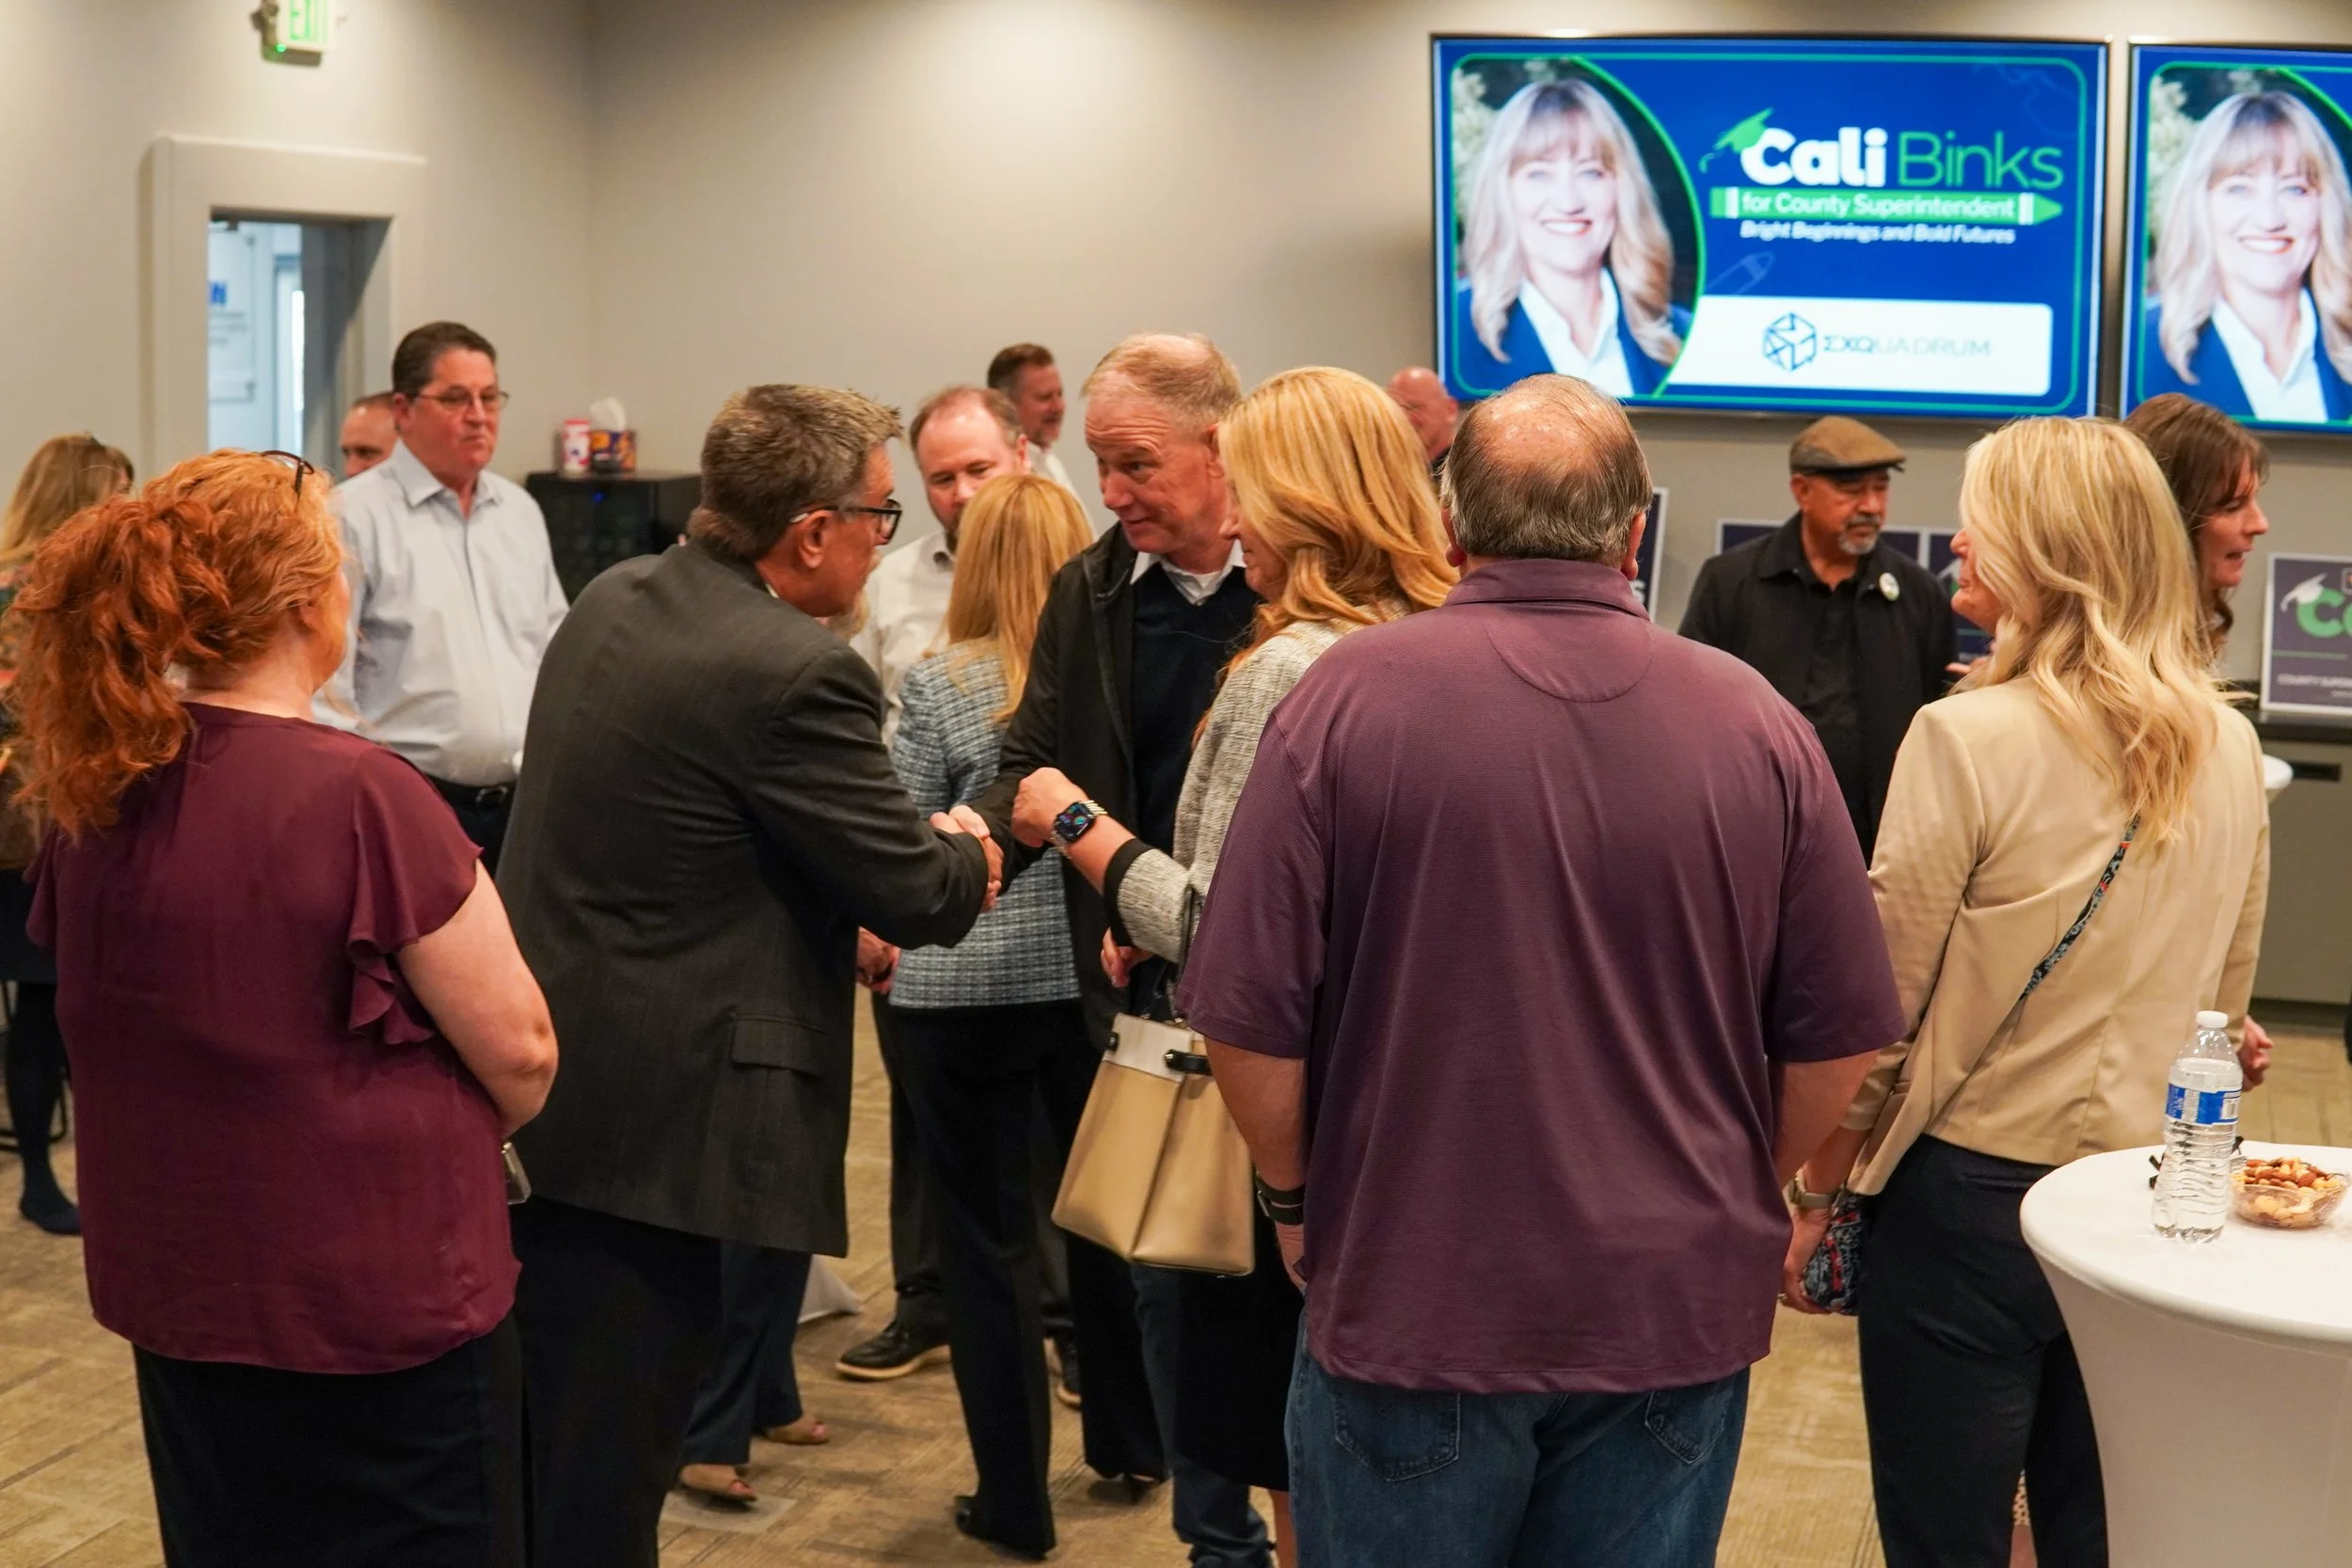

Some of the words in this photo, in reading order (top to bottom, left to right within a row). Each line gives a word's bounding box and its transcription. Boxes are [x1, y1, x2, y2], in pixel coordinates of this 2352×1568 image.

[1740, 126, 1888, 187] Cali
[1898, 130, 2064, 190] Binks
[1742, 191, 1772, 214] for
[1774, 192, 1851, 218] County
[1852, 193, 2015, 219] Superintendent
[1740, 219, 1791, 242] Bright
[1791, 220, 1881, 244] Beginnings
[1882, 224, 1914, 243] and
[1914, 223, 1952, 243] Bold
[1952, 224, 2016, 245] Futures
[2297, 588, 2352, 638] C
